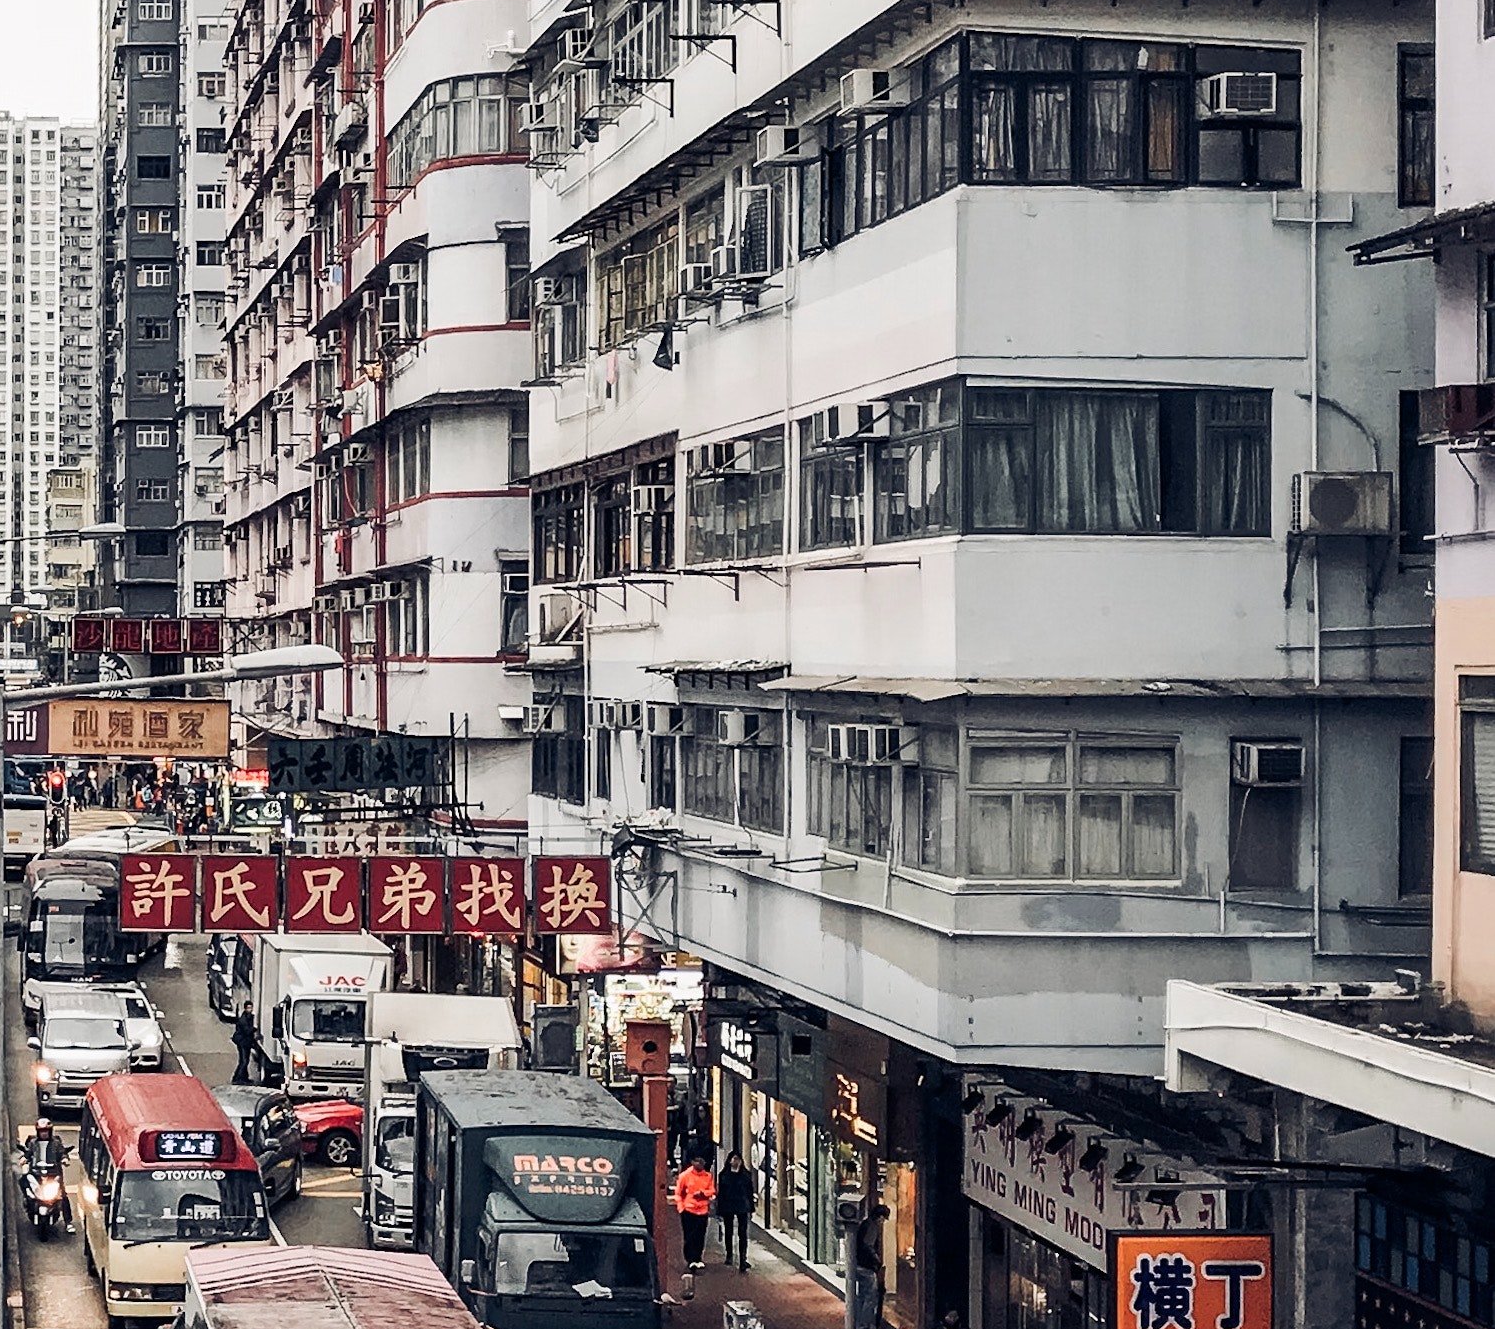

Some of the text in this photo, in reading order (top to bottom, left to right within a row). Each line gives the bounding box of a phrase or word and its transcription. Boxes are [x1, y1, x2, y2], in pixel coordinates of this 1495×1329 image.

[125, 860, 607, 929] 許氏兄弟找換
[319, 975, 367, 987] JAC
[513, 1154, 614, 1175] MARCO
[165, 1170, 212, 1181] TOYOTA
[970, 1158, 1007, 1199] YING
[1014, 1179, 1057, 1226] MING
